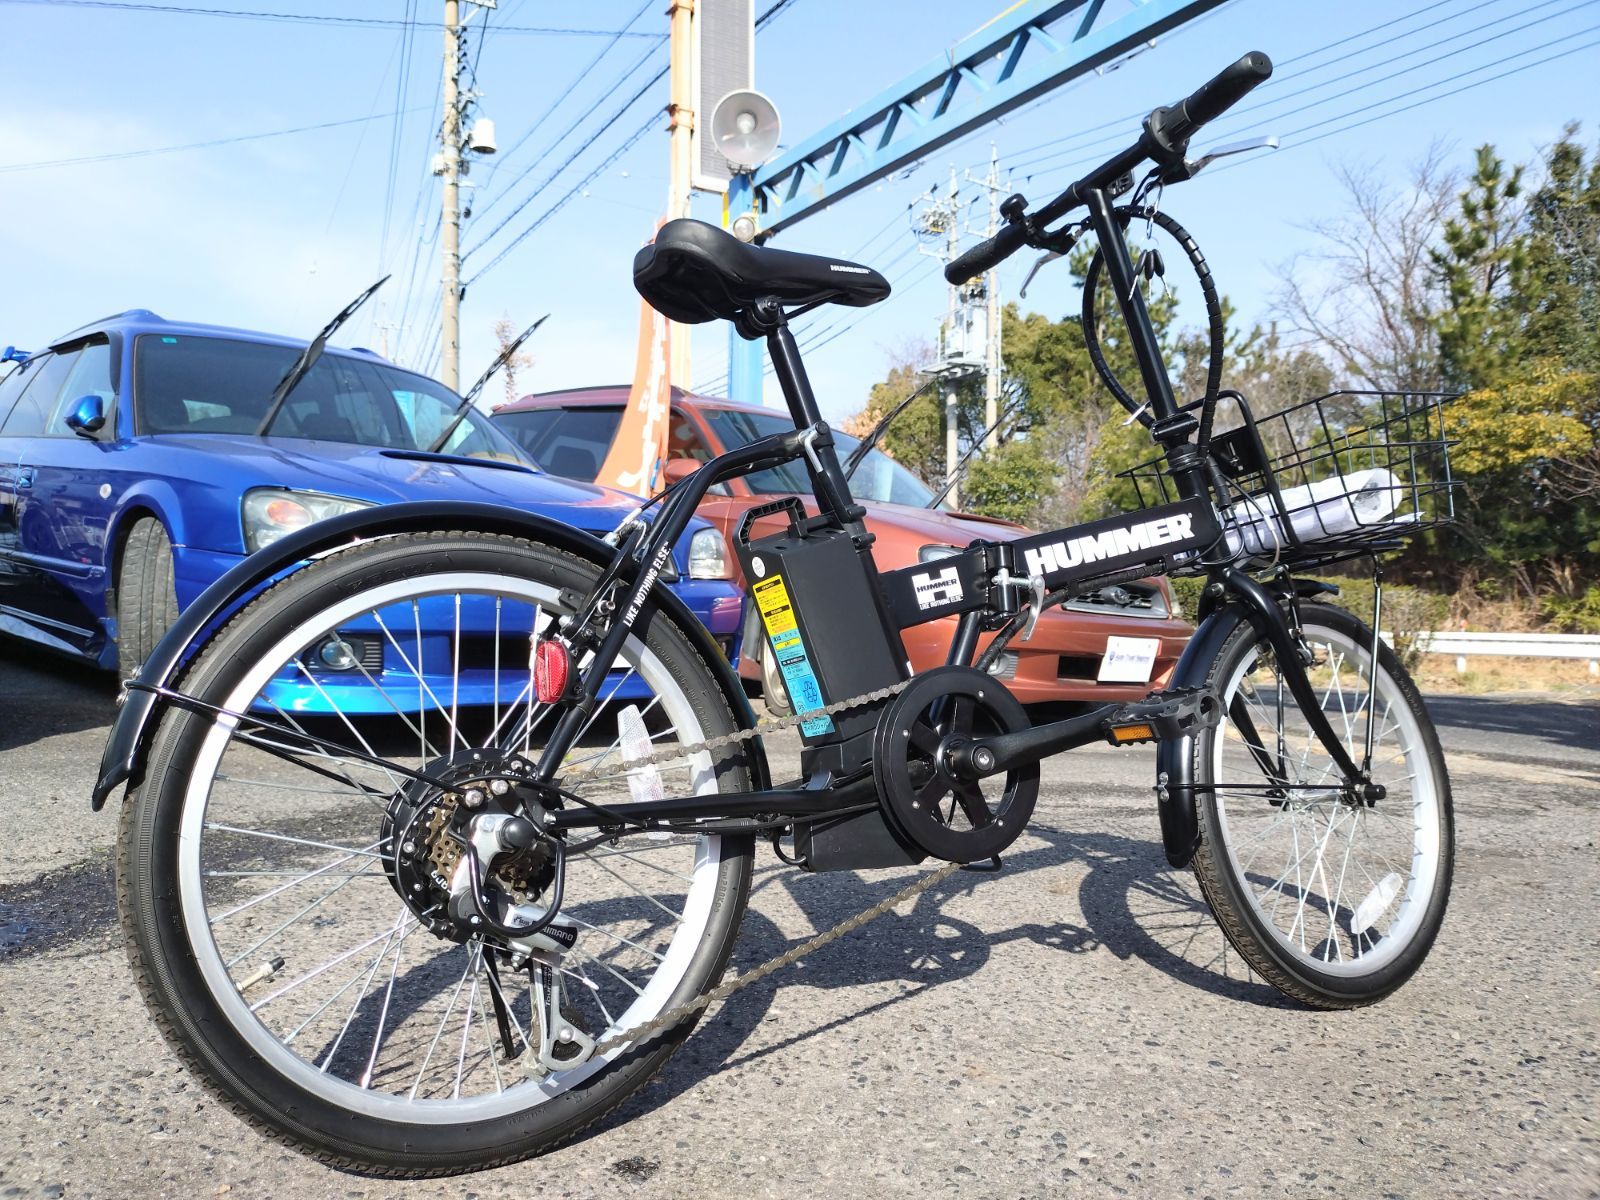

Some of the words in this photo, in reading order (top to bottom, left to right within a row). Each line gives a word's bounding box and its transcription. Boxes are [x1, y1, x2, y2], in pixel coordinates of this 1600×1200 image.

[830, 264, 869, 274] HUMMER
[1024, 512, 1195, 576] HUMMER
[622, 606, 639, 627] LIKE
[633, 568, 658, 608] NOTHING
[916, 578, 958, 593] HUMMER
